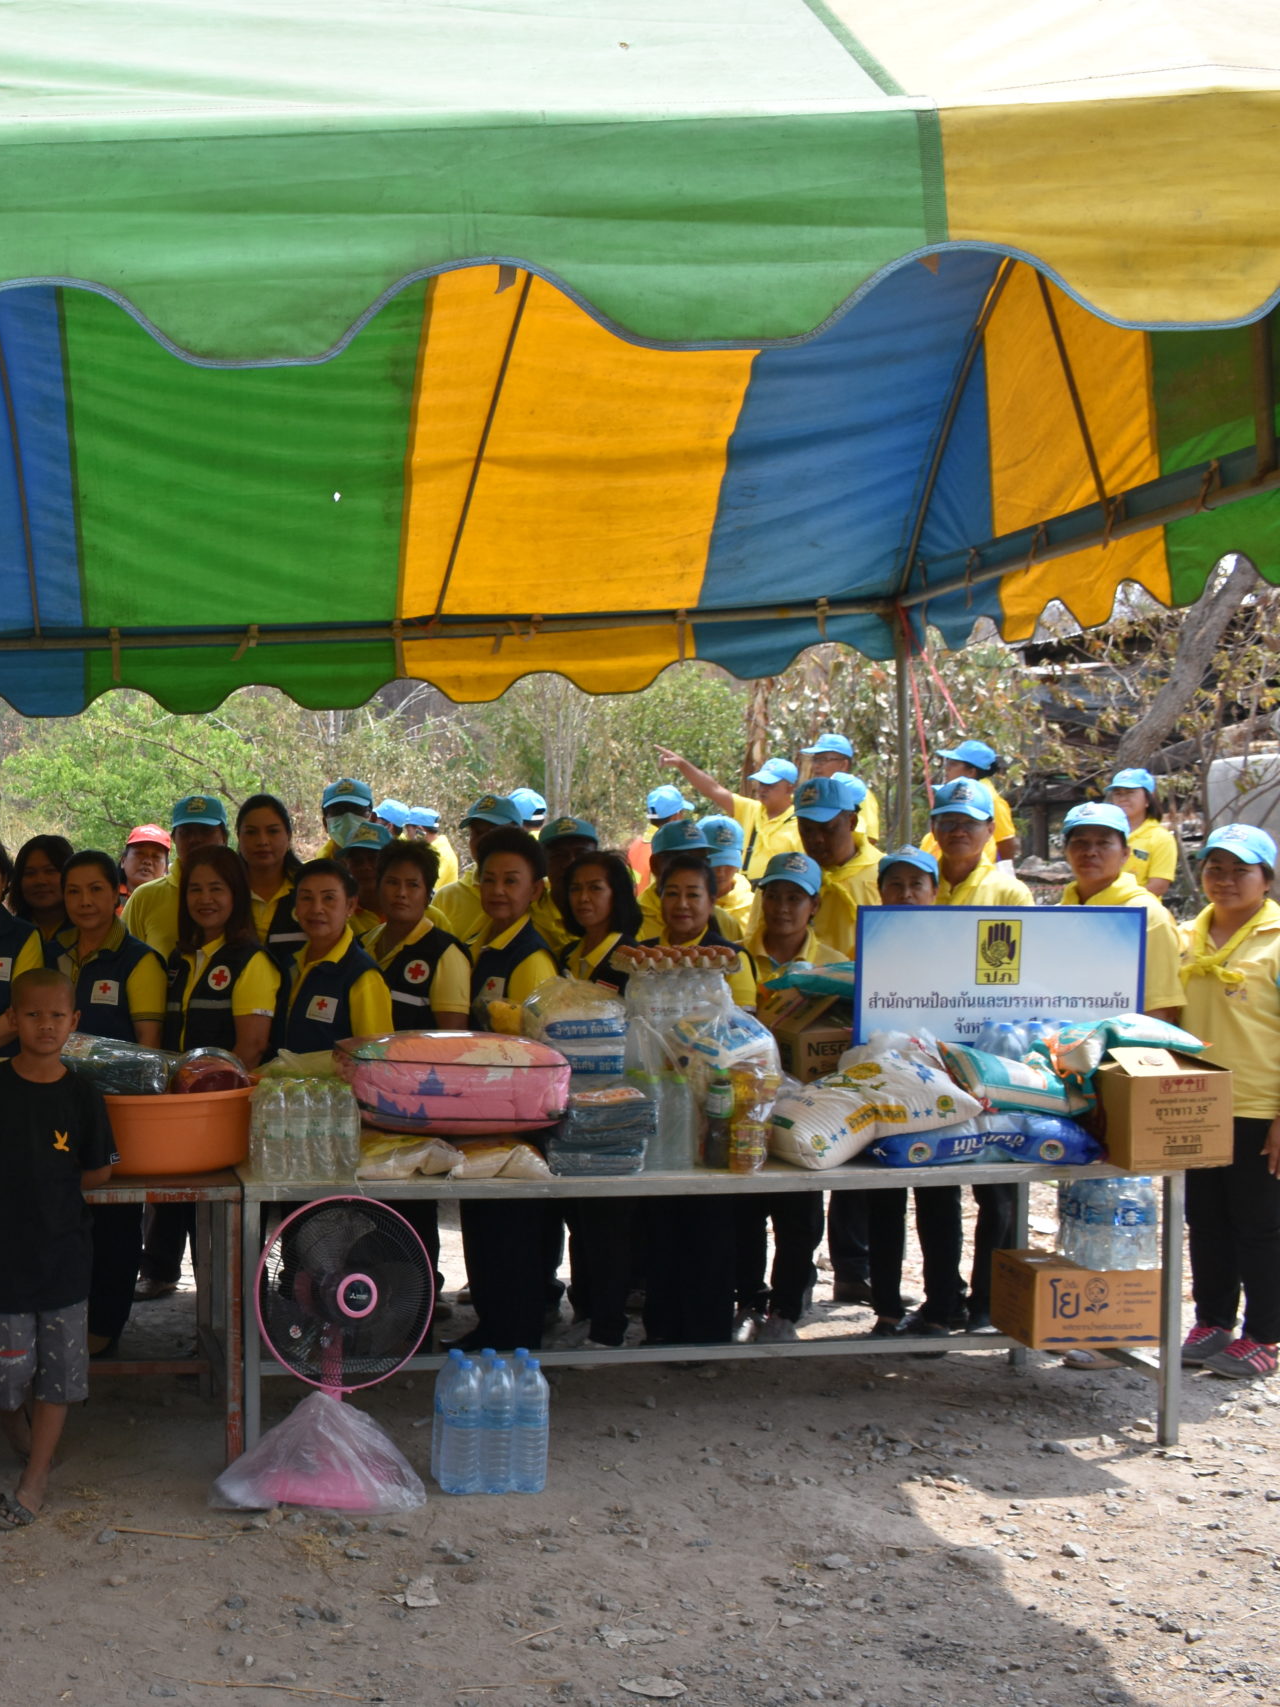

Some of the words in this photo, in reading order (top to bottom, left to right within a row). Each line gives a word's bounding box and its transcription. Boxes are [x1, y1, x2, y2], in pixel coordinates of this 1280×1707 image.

[984, 970, 1015, 983] ปภ.
[868, 991, 1130, 1010] สำนักงานป้องกันและบรรเทาสาธารณภัย
